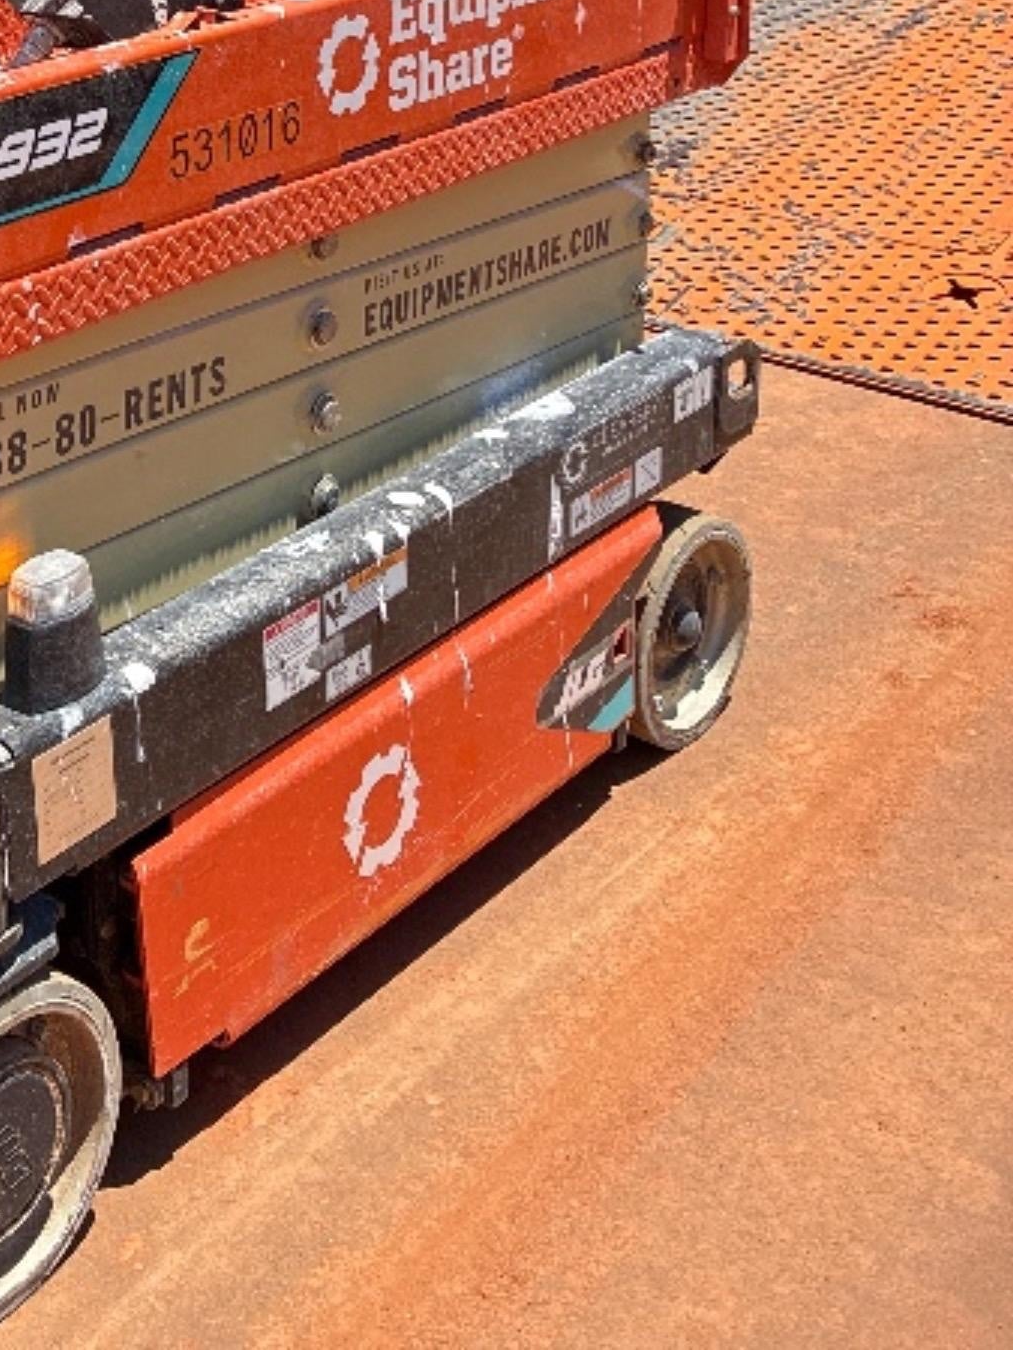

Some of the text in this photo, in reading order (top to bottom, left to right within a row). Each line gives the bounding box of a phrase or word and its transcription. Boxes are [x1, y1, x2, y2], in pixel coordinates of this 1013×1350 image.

[389, 37, 514, 112] Share
[169, 100, 301, 180] 531016
[364, 215, 613, 337] EQUIPMENTSHARE.COM
[16, 382, 61, 414] NOW
